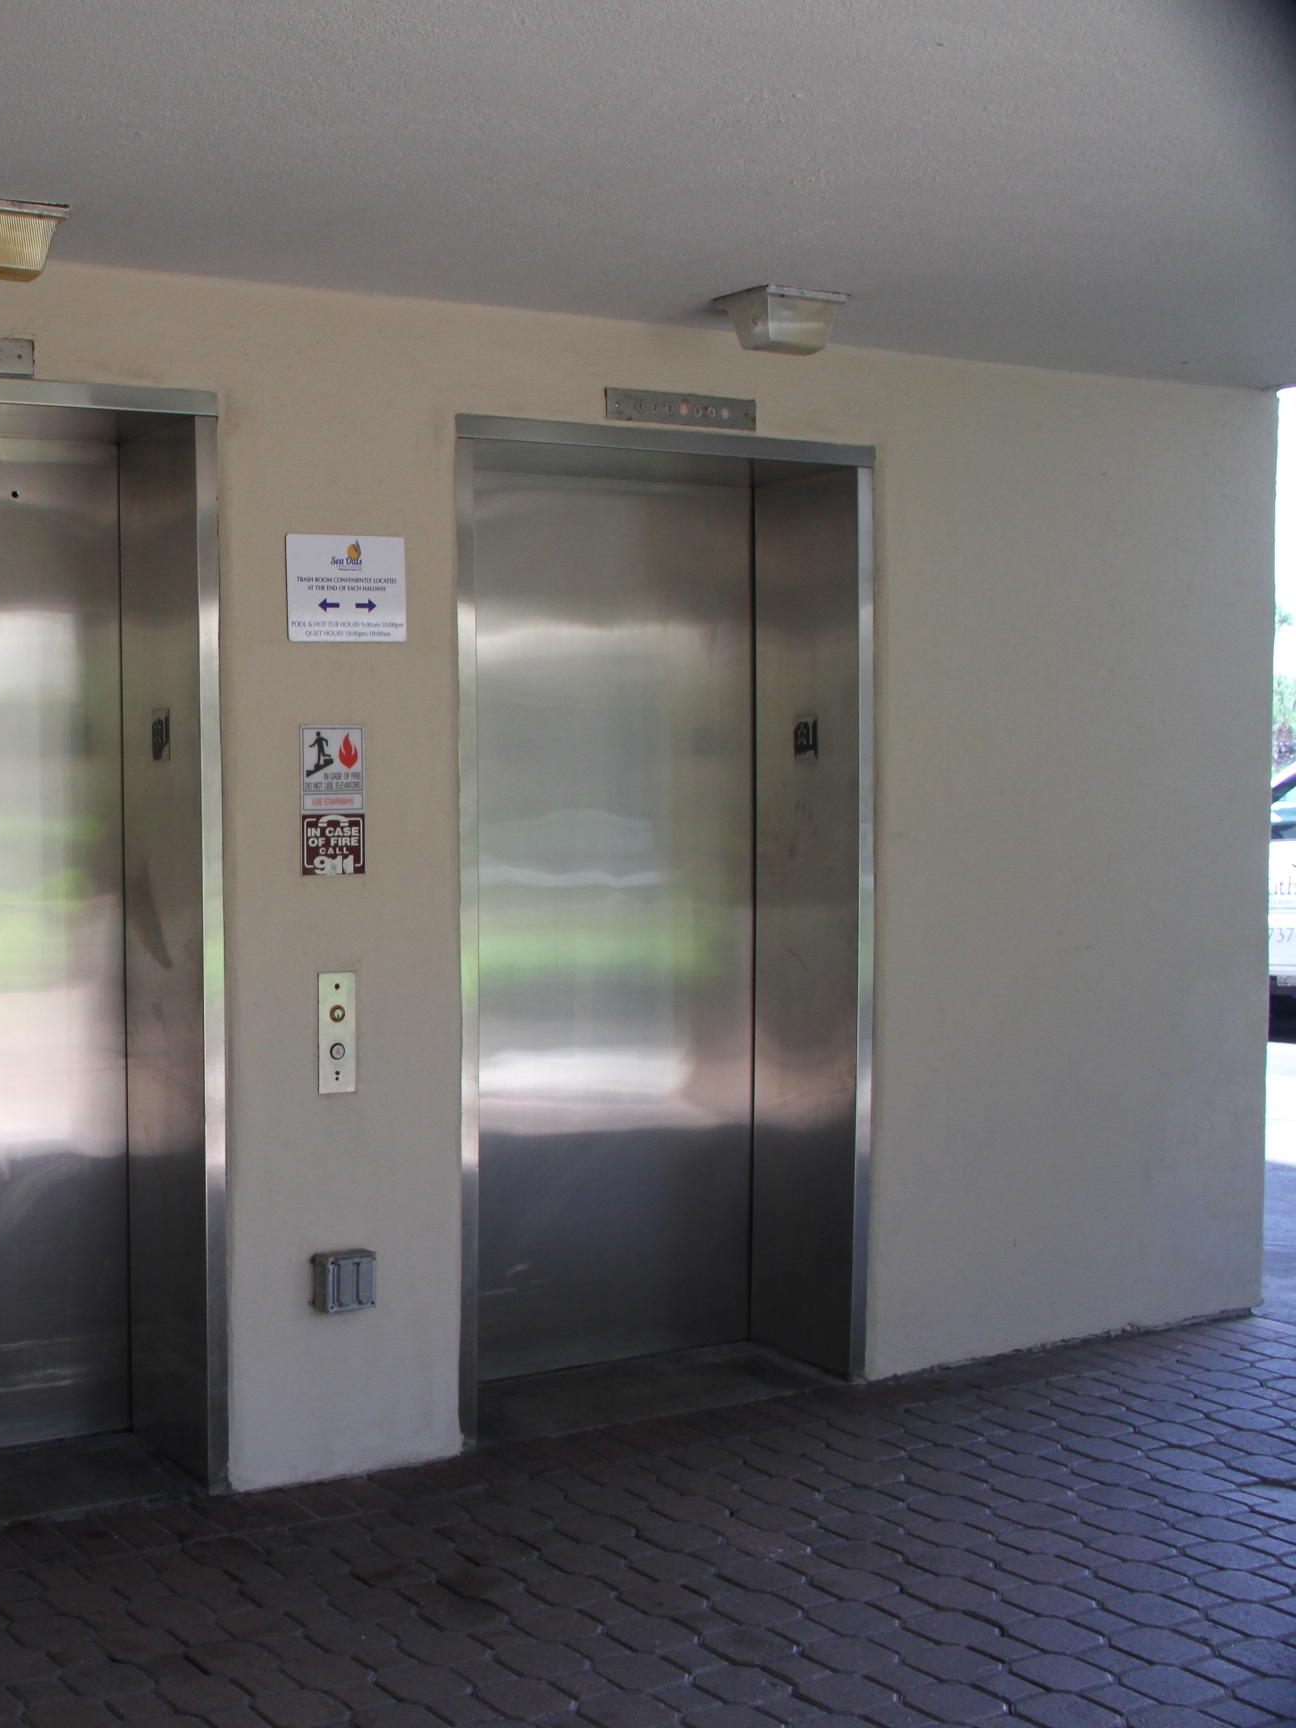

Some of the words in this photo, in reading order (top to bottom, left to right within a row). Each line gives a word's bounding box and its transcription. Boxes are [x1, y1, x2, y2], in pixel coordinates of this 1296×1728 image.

[330, 556, 344, 565] Sea
[346, 556, 362, 565] Oats
[324, 772, 329, 780] IN
[330, 772, 342, 780] CASE
[344, 772, 350, 780] OF
[351, 772, 361, 780] FIRE
[305, 781, 312, 789] DO
[313, 781, 323, 789] NOT
[324, 781, 334, 789] USE
[335, 781, 361, 789] ELEVATORS
[311, 797, 321, 806] USE
[323, 797, 354, 806] STAIRWAYS
[307, 827, 321, 837] IN
[325, 826, 359, 837] CASE
[308, 837, 326, 847] OF
[330, 836, 359, 847] FIRE
[319, 847, 349, 855] CALL
[313, 854, 354, 875] 911
